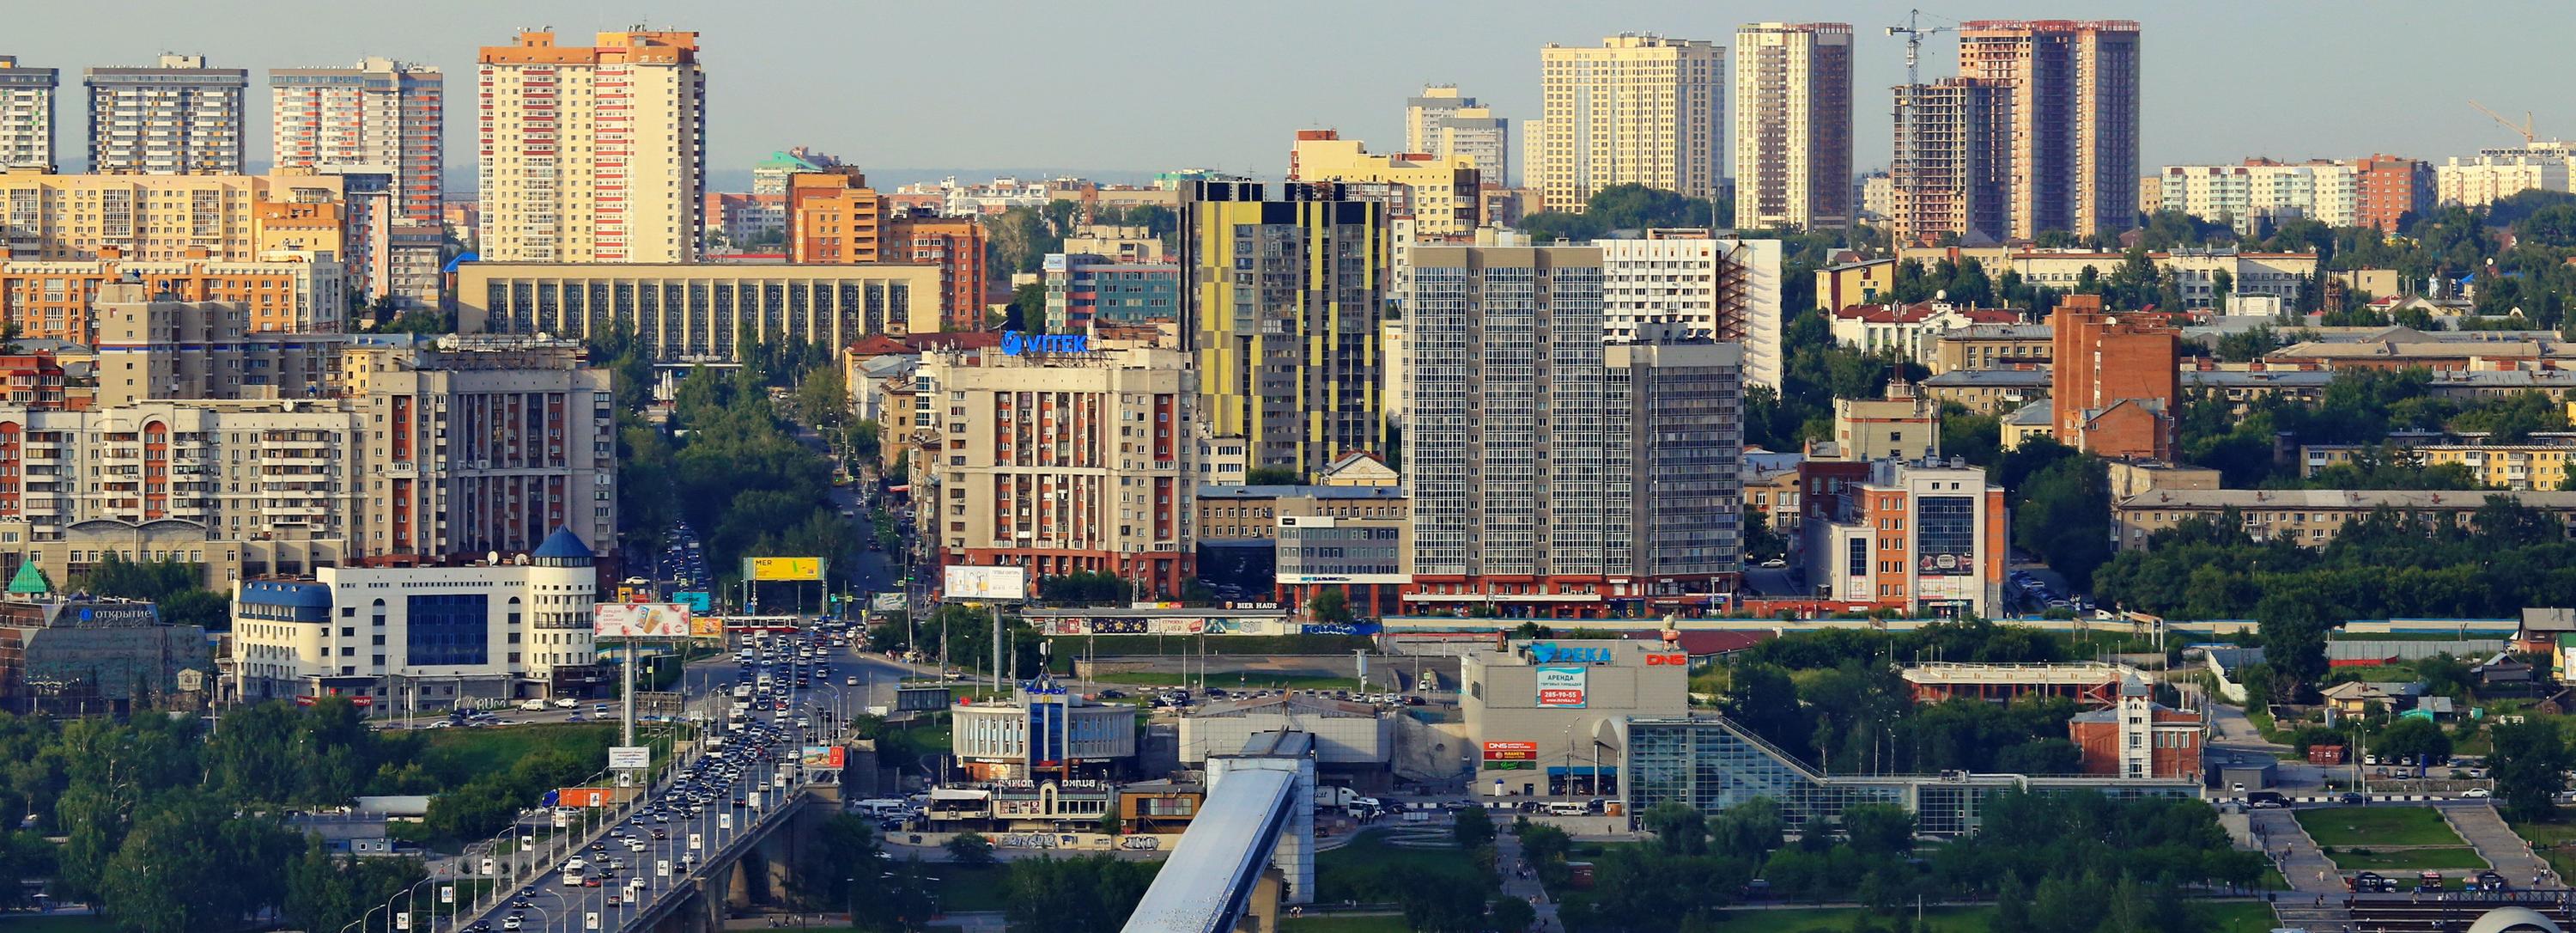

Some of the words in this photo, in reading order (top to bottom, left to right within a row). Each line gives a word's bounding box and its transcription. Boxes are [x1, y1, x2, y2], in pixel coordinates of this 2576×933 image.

[1025, 334, 1088, 353] VITEK
[1560, 648, 1611, 662] РЕКА
[1646, 654, 1687, 666] DNS
